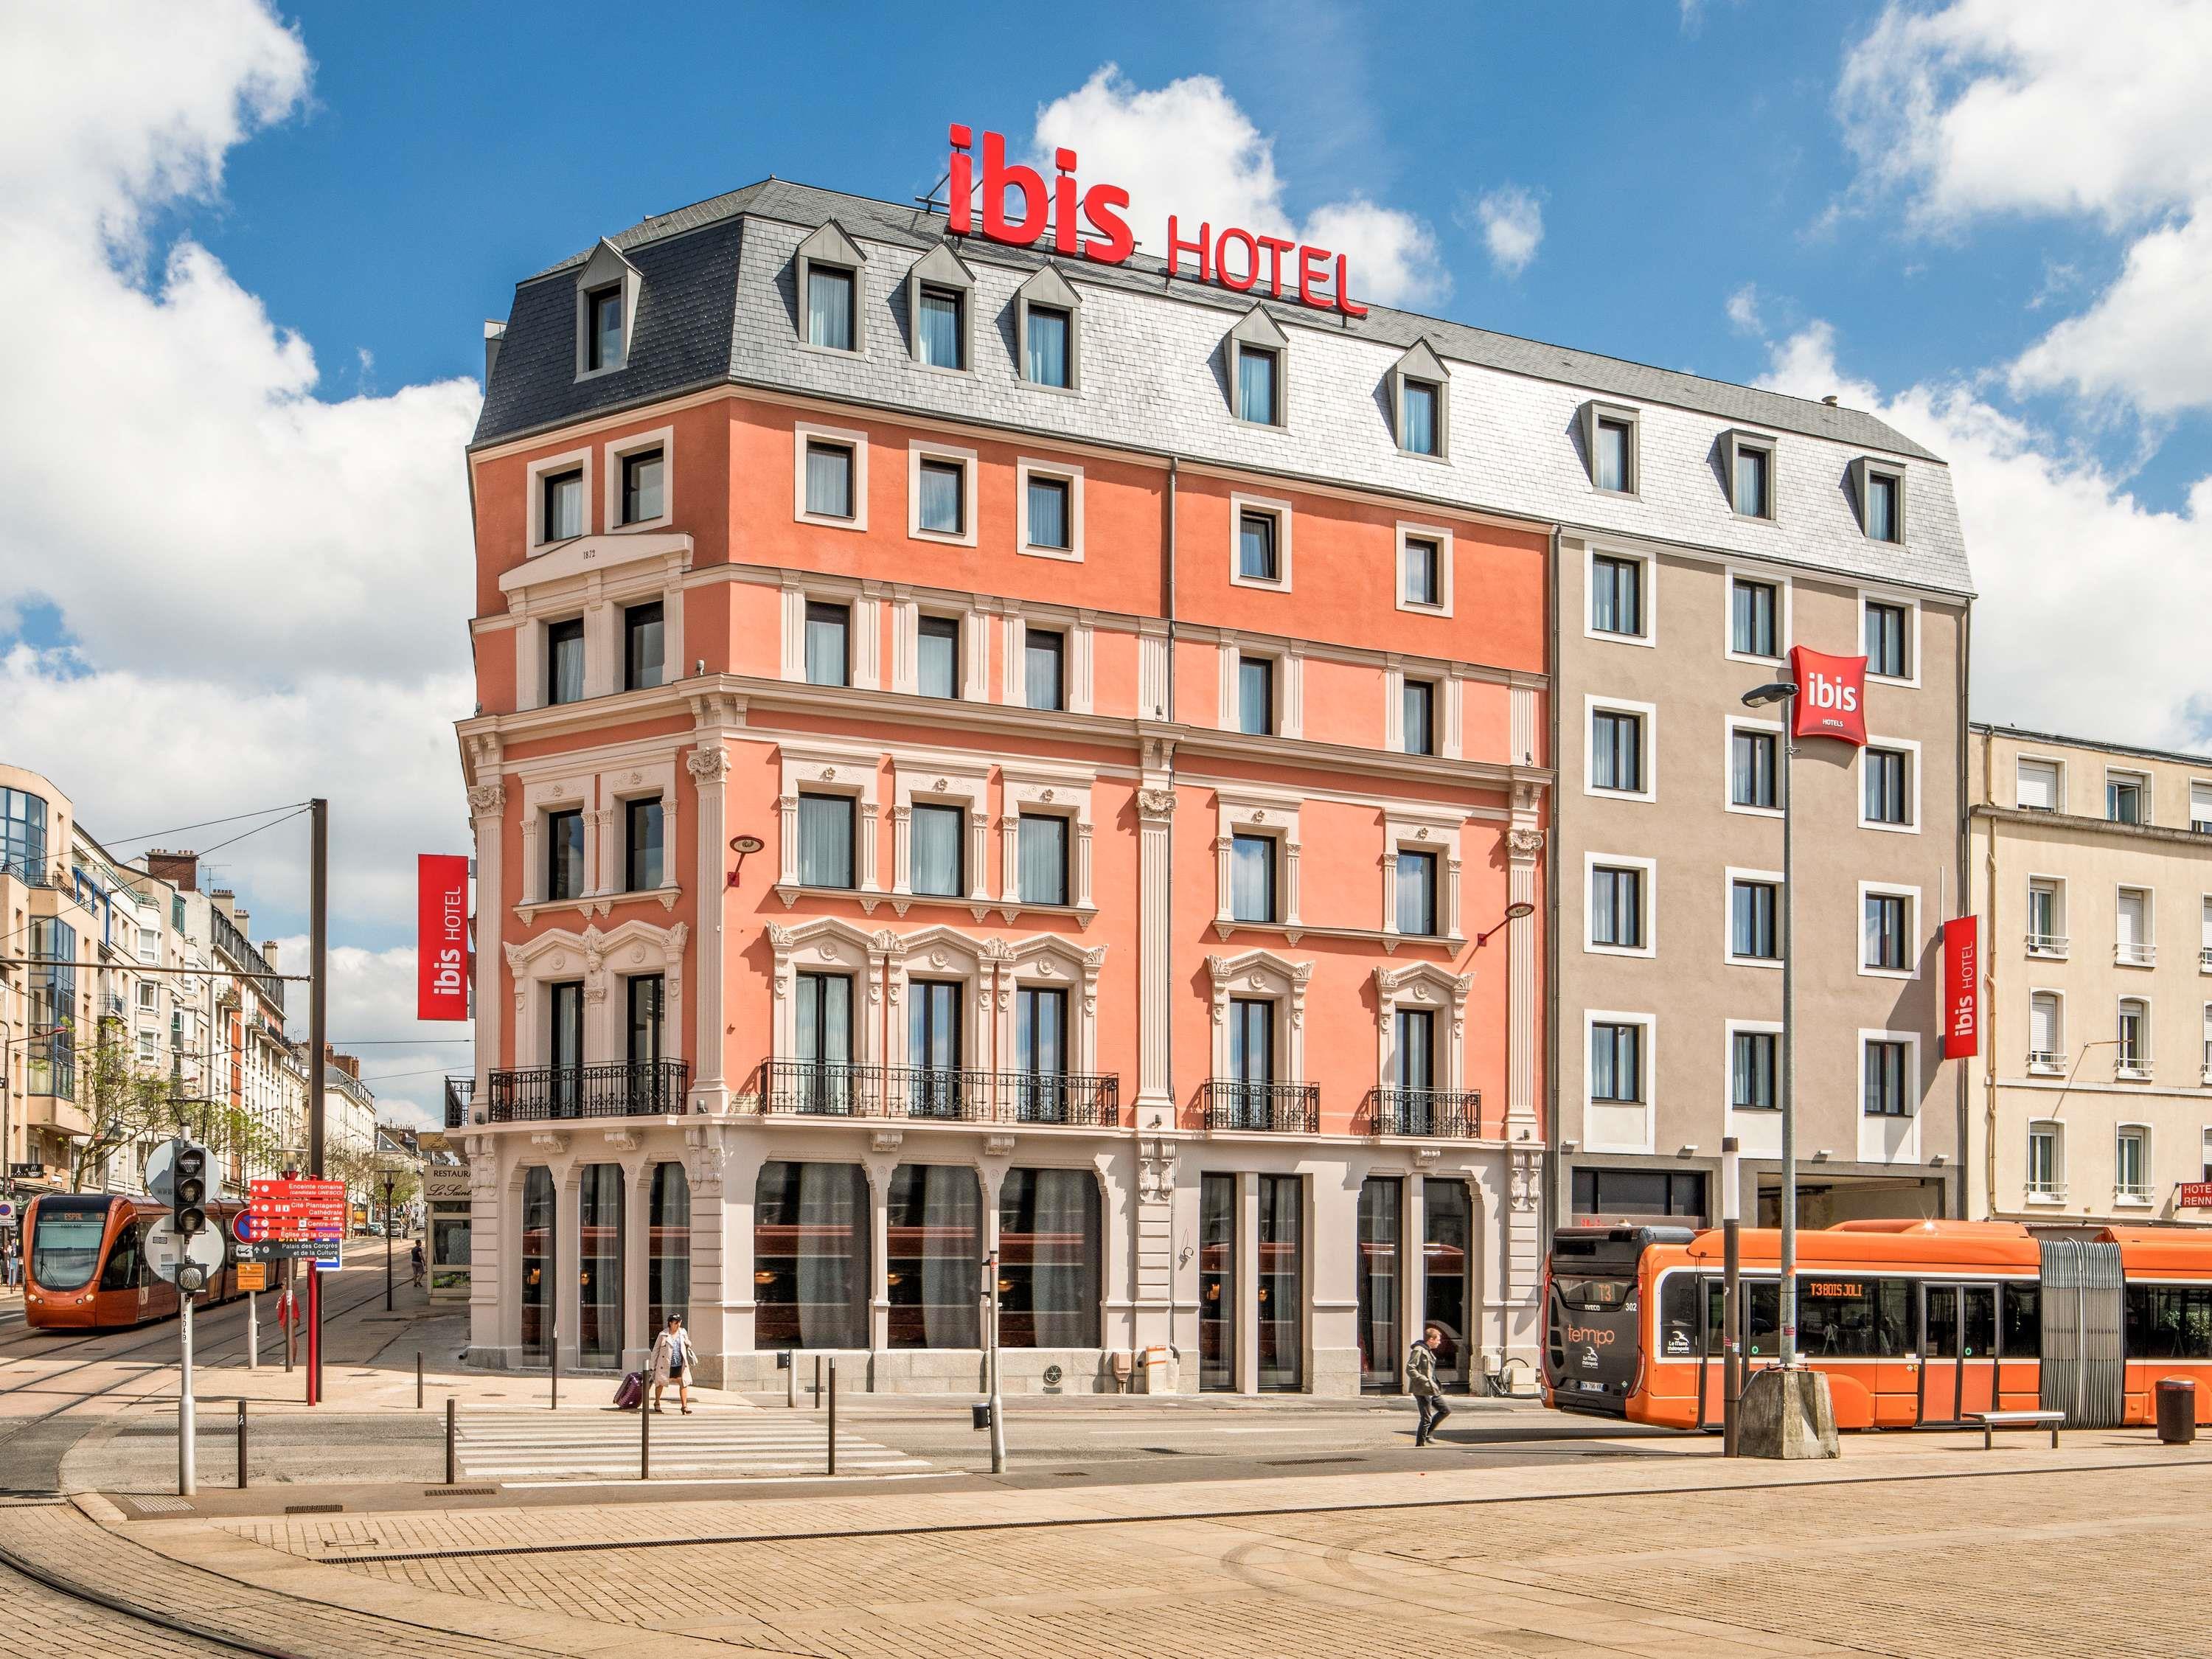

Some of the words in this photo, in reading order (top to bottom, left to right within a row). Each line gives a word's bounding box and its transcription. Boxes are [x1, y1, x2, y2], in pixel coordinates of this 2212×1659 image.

[950, 124, 1134, 264] ibis
[1168, 215, 1368, 316] HOTEL
[583, 549, 596, 560] 1872
[1809, 672, 1857, 712] ibis
[1822, 719, 1843, 727] HOTELS
[445, 886, 461, 940] HOTEL
[434, 949, 461, 995] ibis
[1961, 941, 1973, 989] HOTEL
[1955, 995, 1973, 1037] ibis
[2184, 1184, 2212, 1194] HOTE
[306, 1202, 343, 1210] Plantagenêt
[2184, 1196, 2212, 1206] RENN
[1599, 1284, 1612, 1301] T3
[1810, 1284, 1823, 1296] T3
[1823, 1284, 1842, 1296] BOIS
[1843, 1284, 1863, 1296] JOLI
[1625, 1302, 1637, 1311] 302
[1568, 1324, 1615, 1349] tempo
